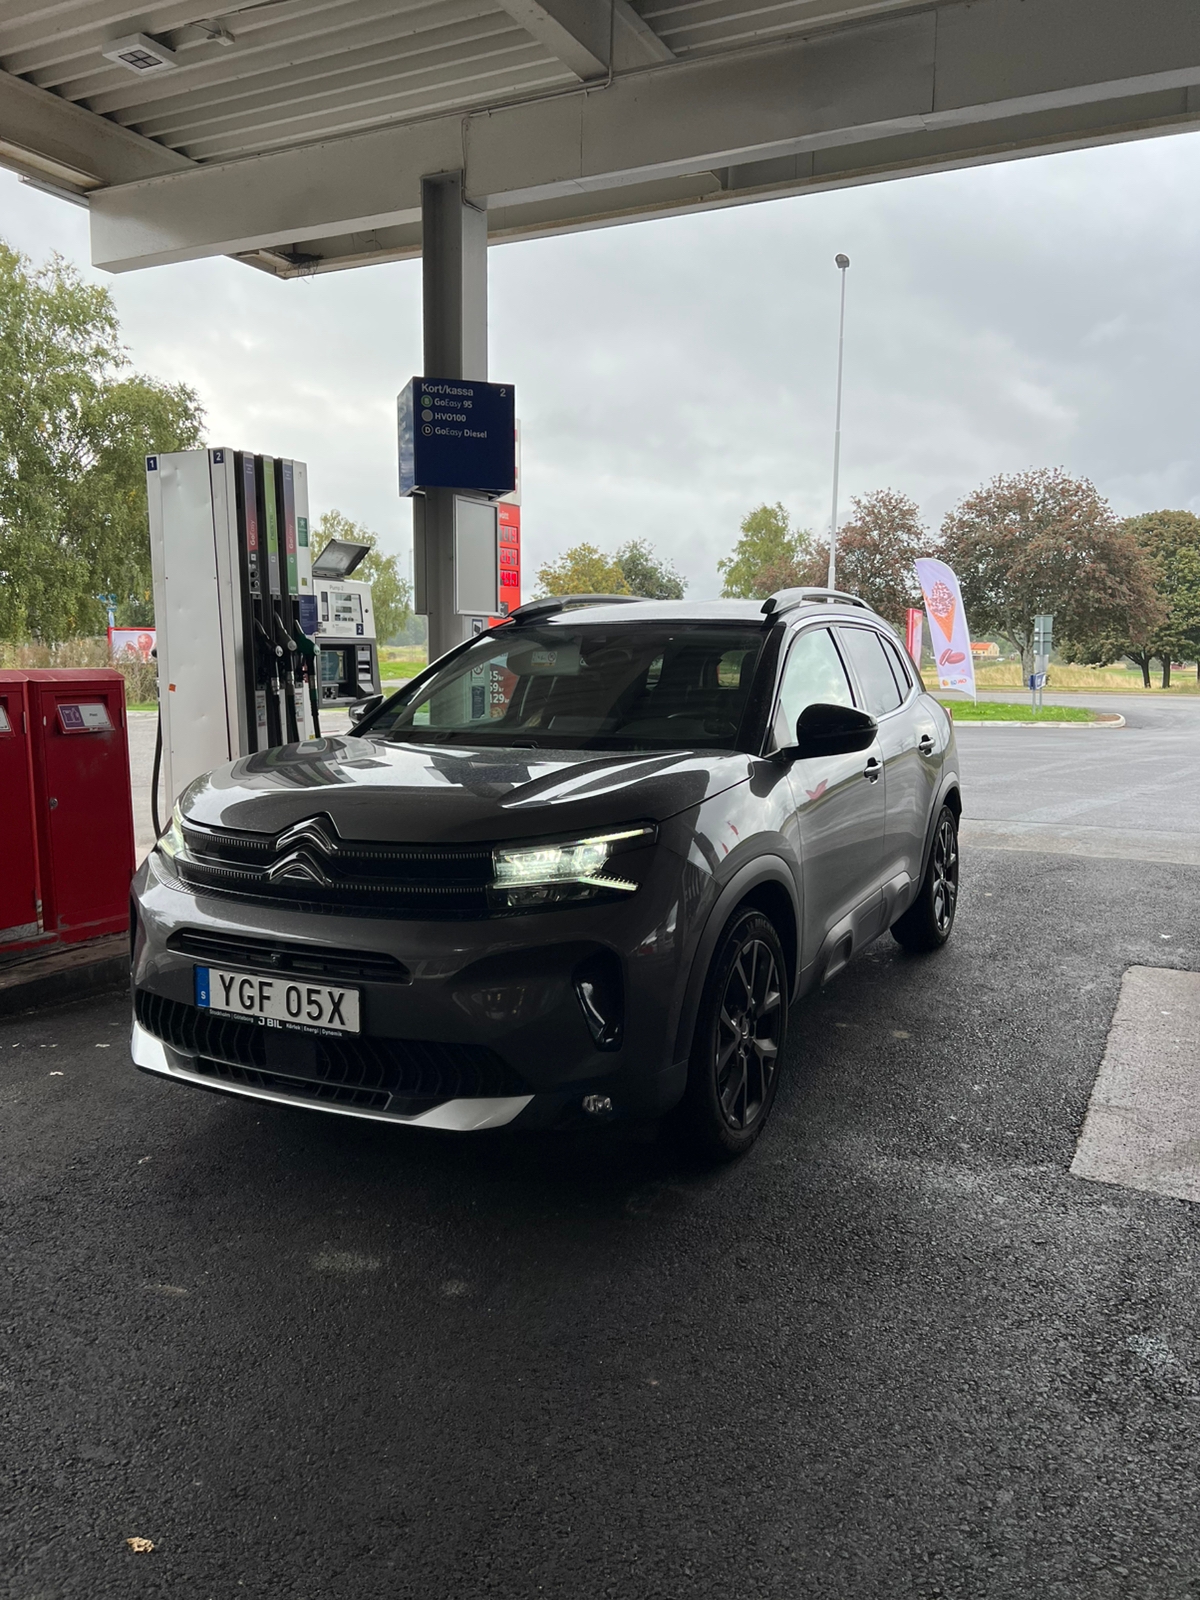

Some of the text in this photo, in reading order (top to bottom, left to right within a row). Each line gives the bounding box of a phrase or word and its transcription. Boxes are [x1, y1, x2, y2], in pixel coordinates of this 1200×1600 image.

[421, 383, 474, 397] Kort/kassa
[500, 388, 507, 397] 2
[434, 398, 462, 409] GoEasy
[463, 400, 473, 409] 95
[434, 413, 467, 422] HVO100
[435, 426, 462, 438] GoEasy
[464, 429, 488, 439] Diesel
[215, 452, 222, 461] 2
[150, 460, 155, 468] 1
[357, 625, 362, 633] 2
[201, 990, 206, 999] S
[218, 973, 346, 1026] YGF 05X
[266, 1018, 283, 1029] BIL
